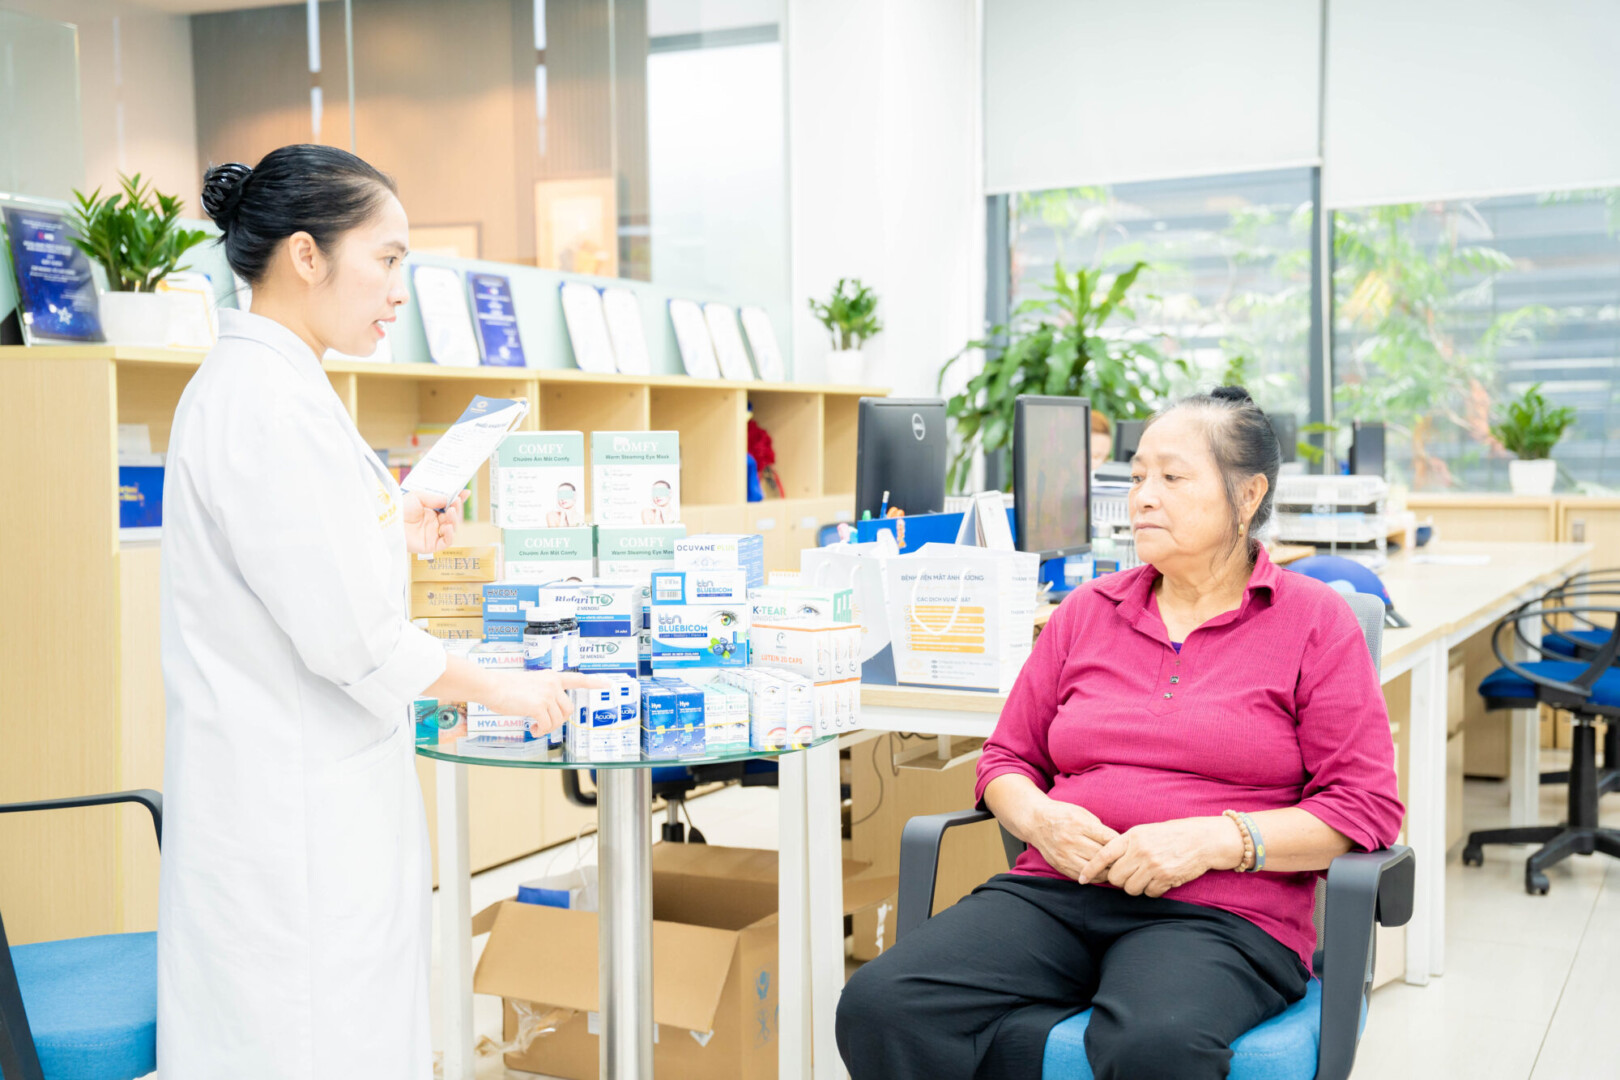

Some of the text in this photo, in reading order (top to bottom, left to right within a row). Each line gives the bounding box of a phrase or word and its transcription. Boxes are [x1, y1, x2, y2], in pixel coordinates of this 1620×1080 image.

[518, 443, 564, 454] COMFY
[524, 538, 570, 548] COMFY
[619, 537, 665, 547] COMFY
[676, 544, 715, 552] OCUVANE
[454, 557, 480, 569] EYE
[964, 573, 984, 581] ƯƠNG
[454, 593, 480, 605] EYE
[488, 625, 519, 633] HYCOM
[658, 624, 708, 632] BLUEBICOM
[761, 654, 779, 663] LUTEIN
